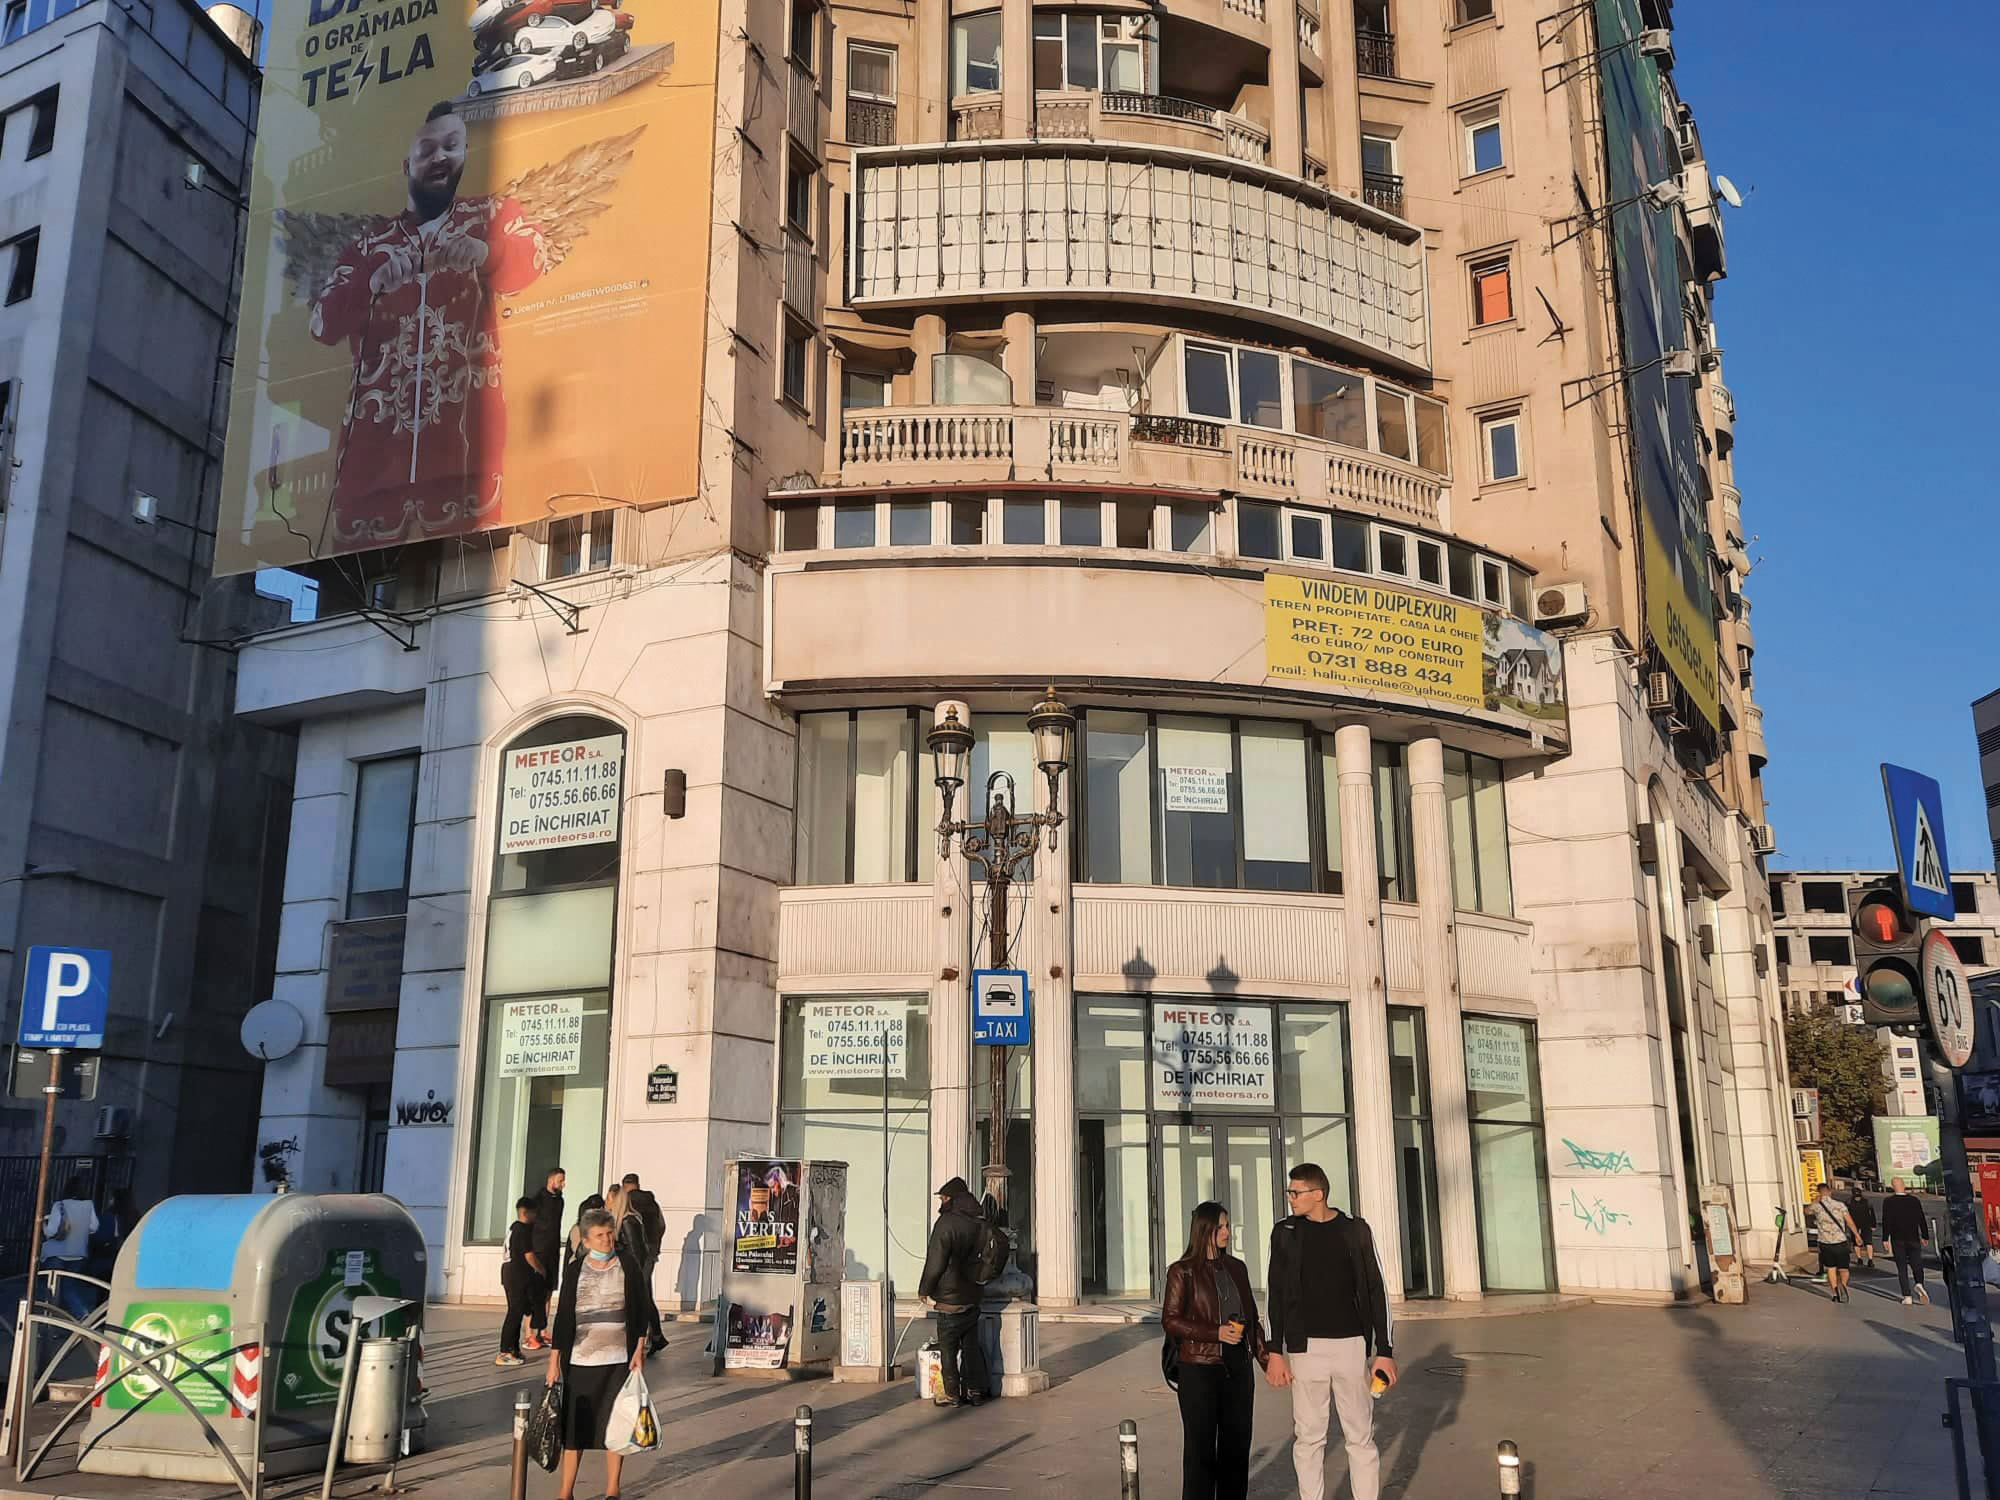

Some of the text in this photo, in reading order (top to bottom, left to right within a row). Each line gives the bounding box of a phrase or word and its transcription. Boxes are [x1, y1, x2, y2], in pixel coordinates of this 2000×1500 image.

[305, 36, 320, 57] O
[324, 0, 439, 50] GRĂMADA
[350, 43, 364, 55] DE
[1302, 581, 1457, 623] VINDEM DUPLEXURI
[1269, 598, 1312, 613] TEREN
[1400, 618, 1431, 633] CASA
[1434, 623, 1447, 634] LA
[1450, 628, 1480, 642] CHEIE
[1292, 618, 1464, 657] PRET: 72 000 EURO
[1291, 633, 1465, 669] 480 EURO/ MP CONSTRUIT
[1666, 599, 1715, 701] getsbet.ro
[1308, 650, 1453, 686] 0731 888 434
[1271, 663, 1481, 706] mail: haliu.nicolae@yahoo.com
[515, 746, 586, 769] METEOR
[531, 761, 617, 788] 0745.11.11.88
[1169, 768, 1207, 776] METEOR
[509, 787, 527, 800] Tel:
[529, 783, 616, 810] 0755.56.66.66
[510, 809, 611, 836] DE ÎNCHIRIAT
[506, 830, 612, 849] www.meteorsa.ro
[41, 952, 91, 1031] P
[1935, 965, 1962, 1030] 60
[510, 1003, 559, 1017] METEOR
[813, 1005, 875, 1018] METEOR
[1163, 1010, 1236, 1026] METEOR
[521, 1016, 580, 1031] 0745.11.11.88
[827, 1019, 903, 1033] 0745.11.11.88
[986, 1022, 1017, 1038] TAXI
[1468, 1024, 1503, 1037] METEOR
[519, 1032, 580, 1047] 0755.56.66.66
[809, 1029, 824, 1039] Tel:
[1182, 1030, 1268, 1047] 0745.11.11.88
[1160, 1040, 1178, 1053] Tel:
[506, 1050, 575, 1065] DE ÎNCHIRIAT
[810, 1051, 899, 1065] DE ÎNCHIRIAT
[1181, 1049, 1269, 1066] 0755.56.66.66
[808, 1066, 901, 1075] www.meteorsro
[1164, 1068, 1265, 1086] DE ÎNCHIRIAT
[1470, 1067, 1520, 1082] DE ÎNCHIRIAT
[1161, 1089, 1269, 1100] www.meteorsa.ro
[739, 1210, 775, 1222] NIS
[737, 1222, 794, 1238] VERTIS
